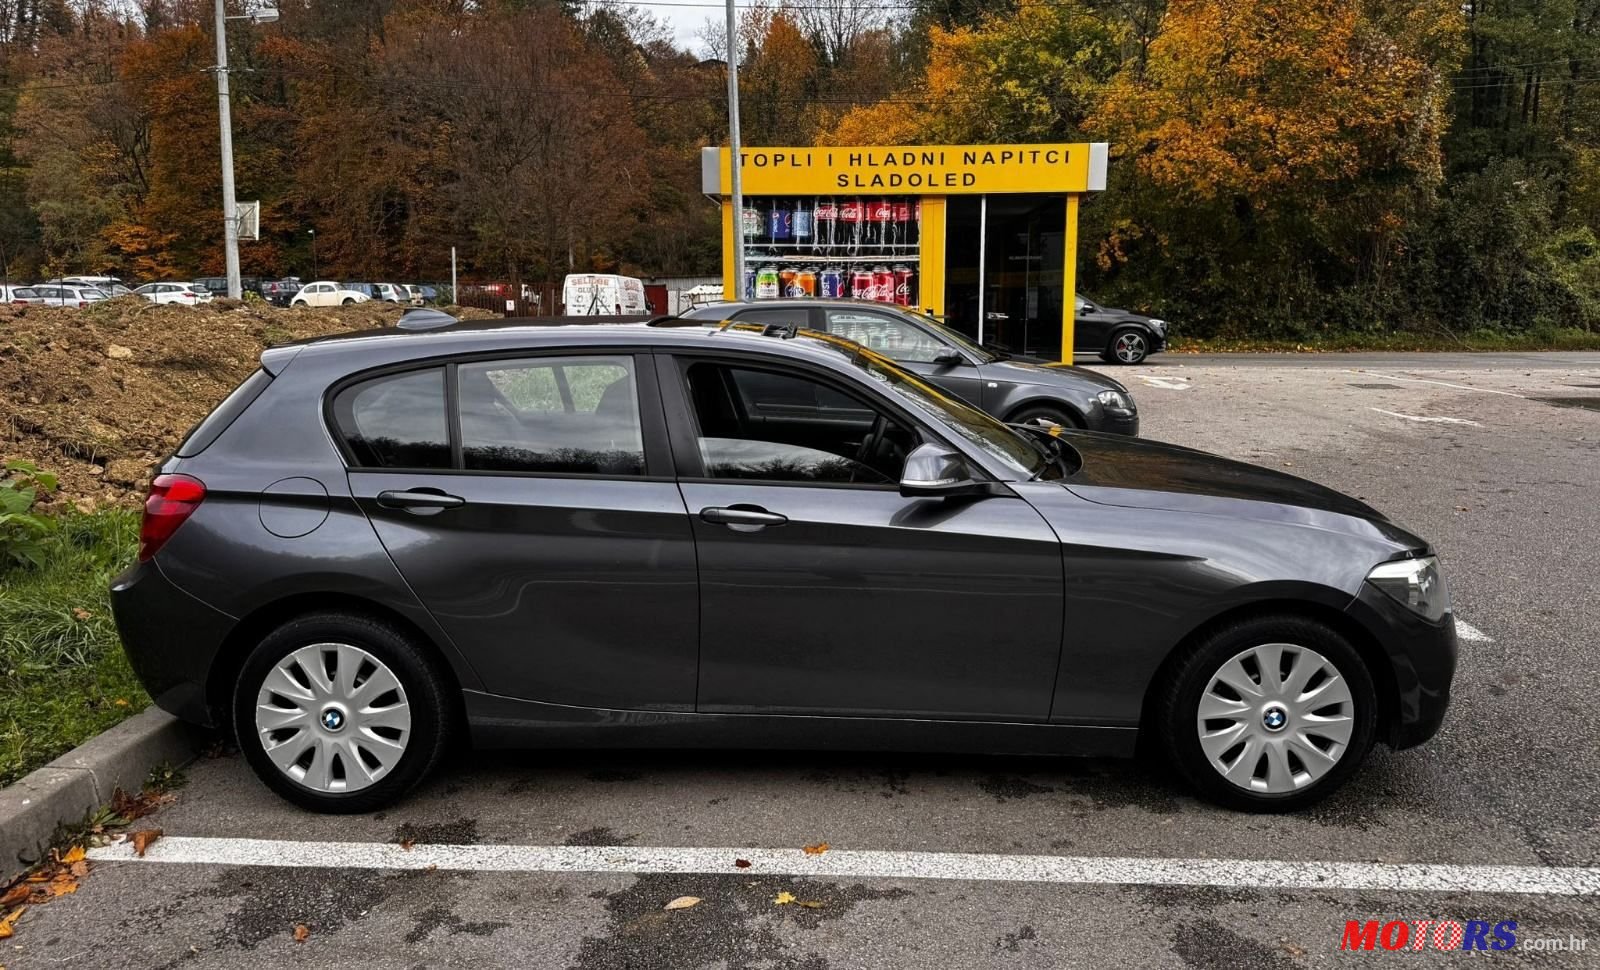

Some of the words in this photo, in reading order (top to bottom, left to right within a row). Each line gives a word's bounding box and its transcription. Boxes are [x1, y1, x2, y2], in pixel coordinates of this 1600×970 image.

[740, 153, 812, 168] TOPLI
[828, 153, 833, 167] I
[849, 151, 945, 167] HLADNI
[963, 150, 1070, 166] NAPITCI
[837, 173, 977, 188] SLADOLED
